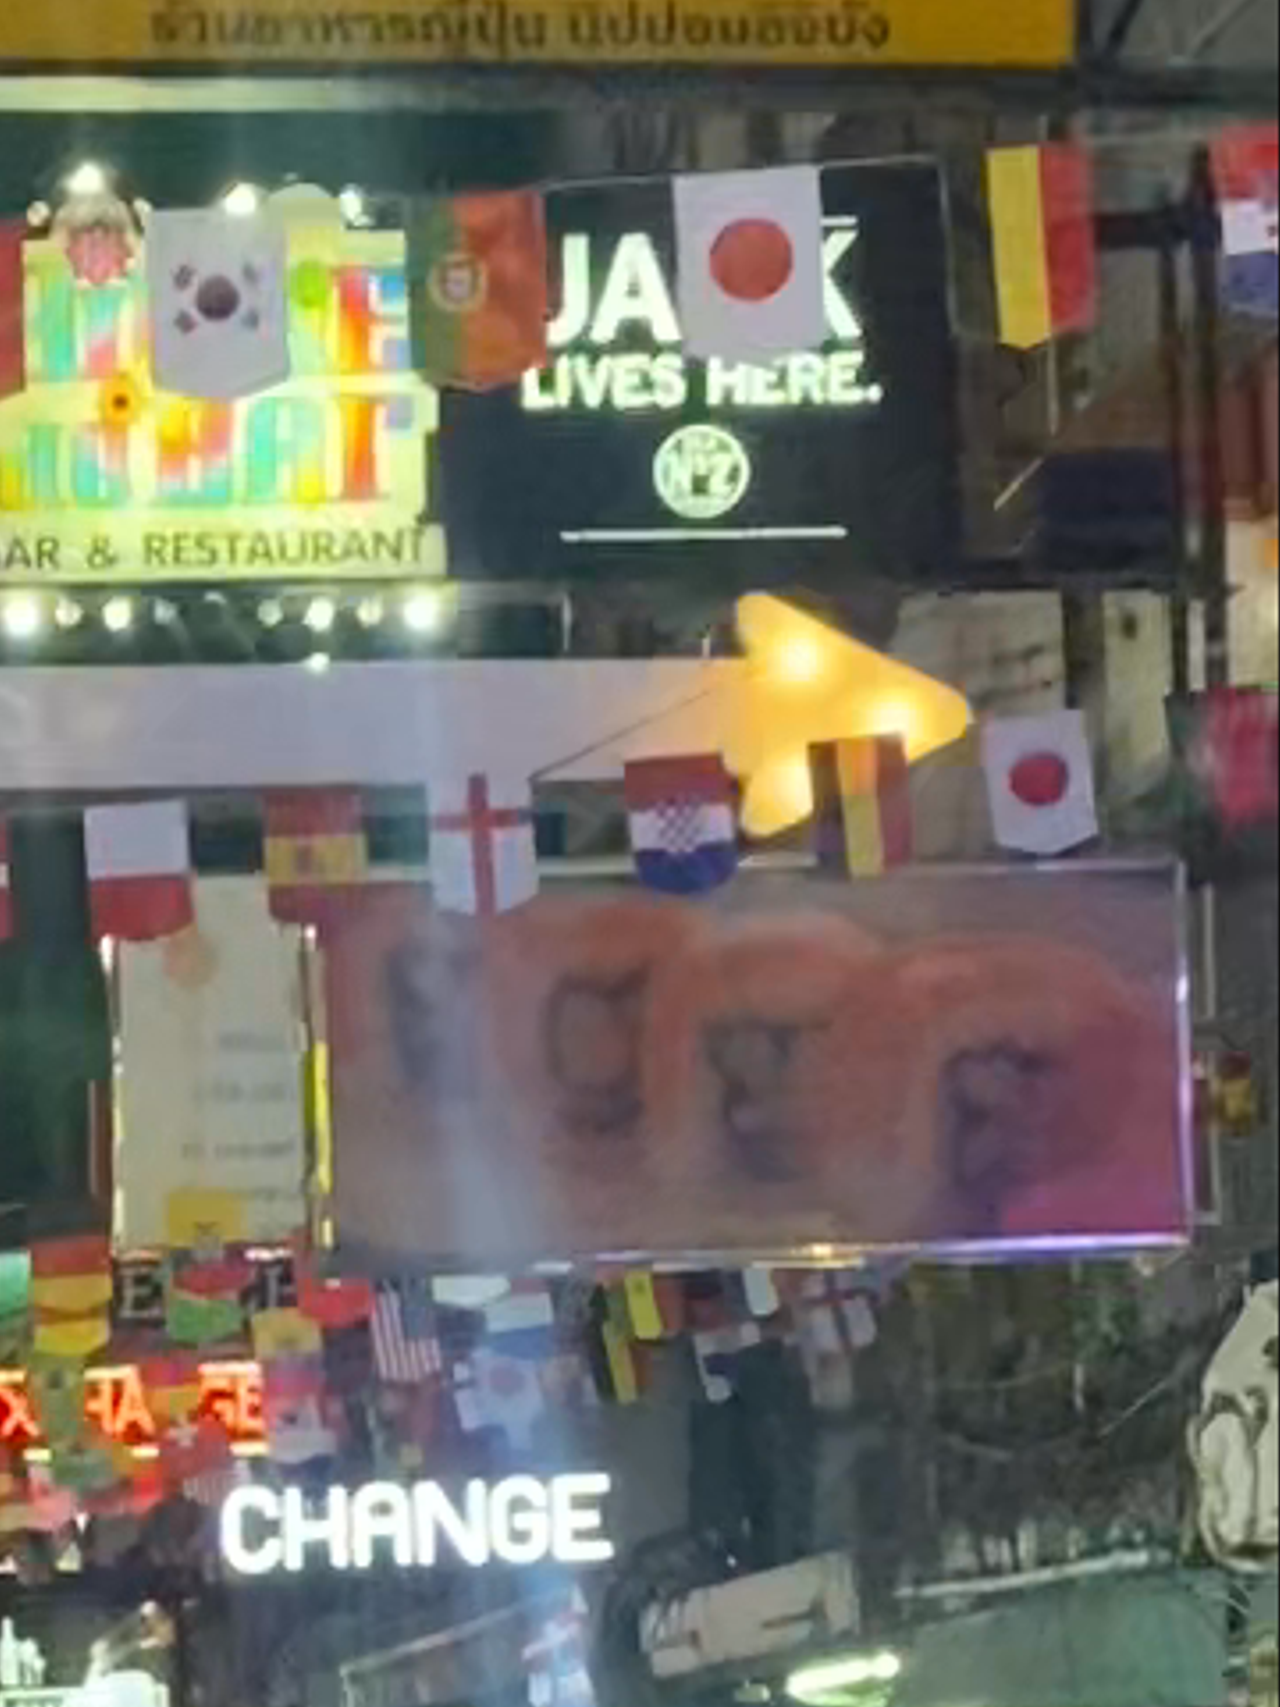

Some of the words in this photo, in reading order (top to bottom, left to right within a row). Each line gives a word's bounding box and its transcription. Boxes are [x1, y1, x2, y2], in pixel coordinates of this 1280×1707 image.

[545, 231, 864, 347] JAK
[521, 351, 688, 412] LIVES
[705, 349, 885, 408] HERE.
[86, 536, 118, 568] &
[142, 526, 428, 567] RESTAURANT
[219, 1472, 615, 1576] CHANGE
